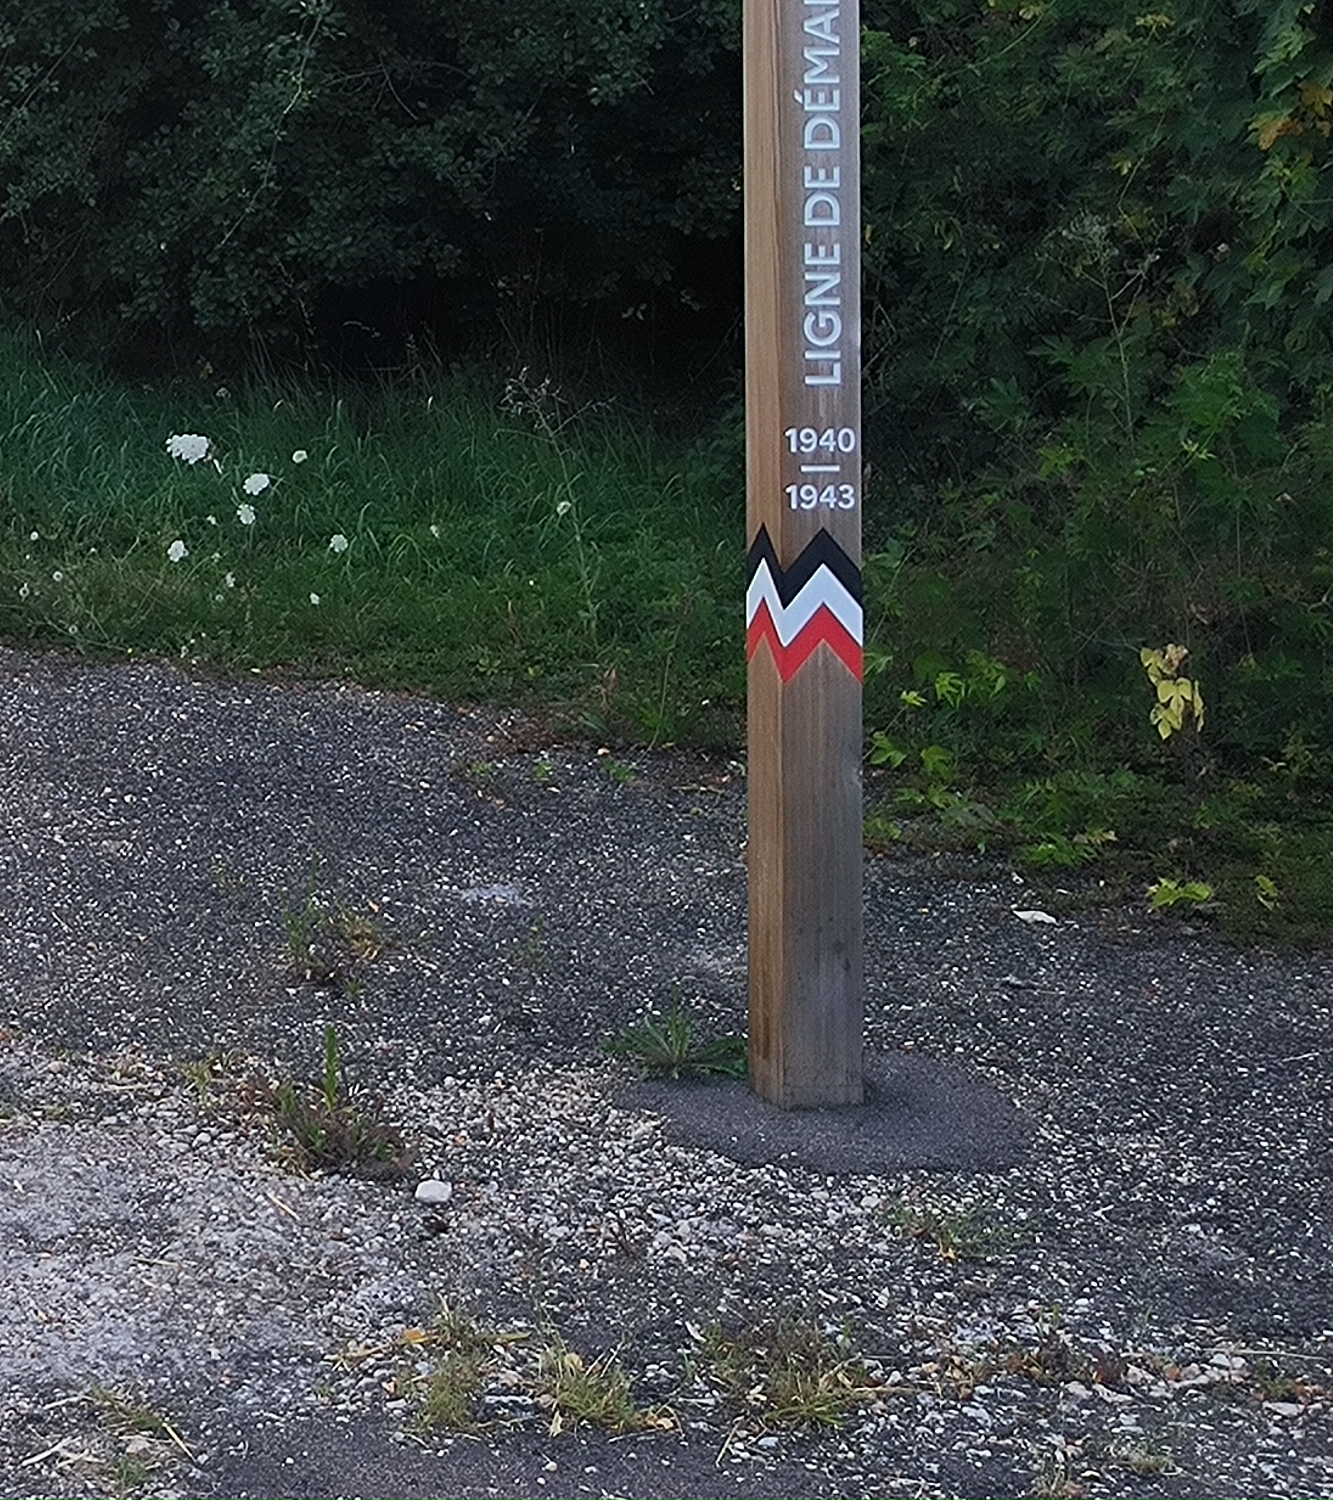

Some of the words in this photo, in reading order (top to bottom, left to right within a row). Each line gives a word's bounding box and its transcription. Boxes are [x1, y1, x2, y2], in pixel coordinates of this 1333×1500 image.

[804, 166, 841, 226] DE
[803, 243, 842, 385] LIGNE
[784, 427, 856, 453] 1940
[784, 484, 855, 510] 1943
